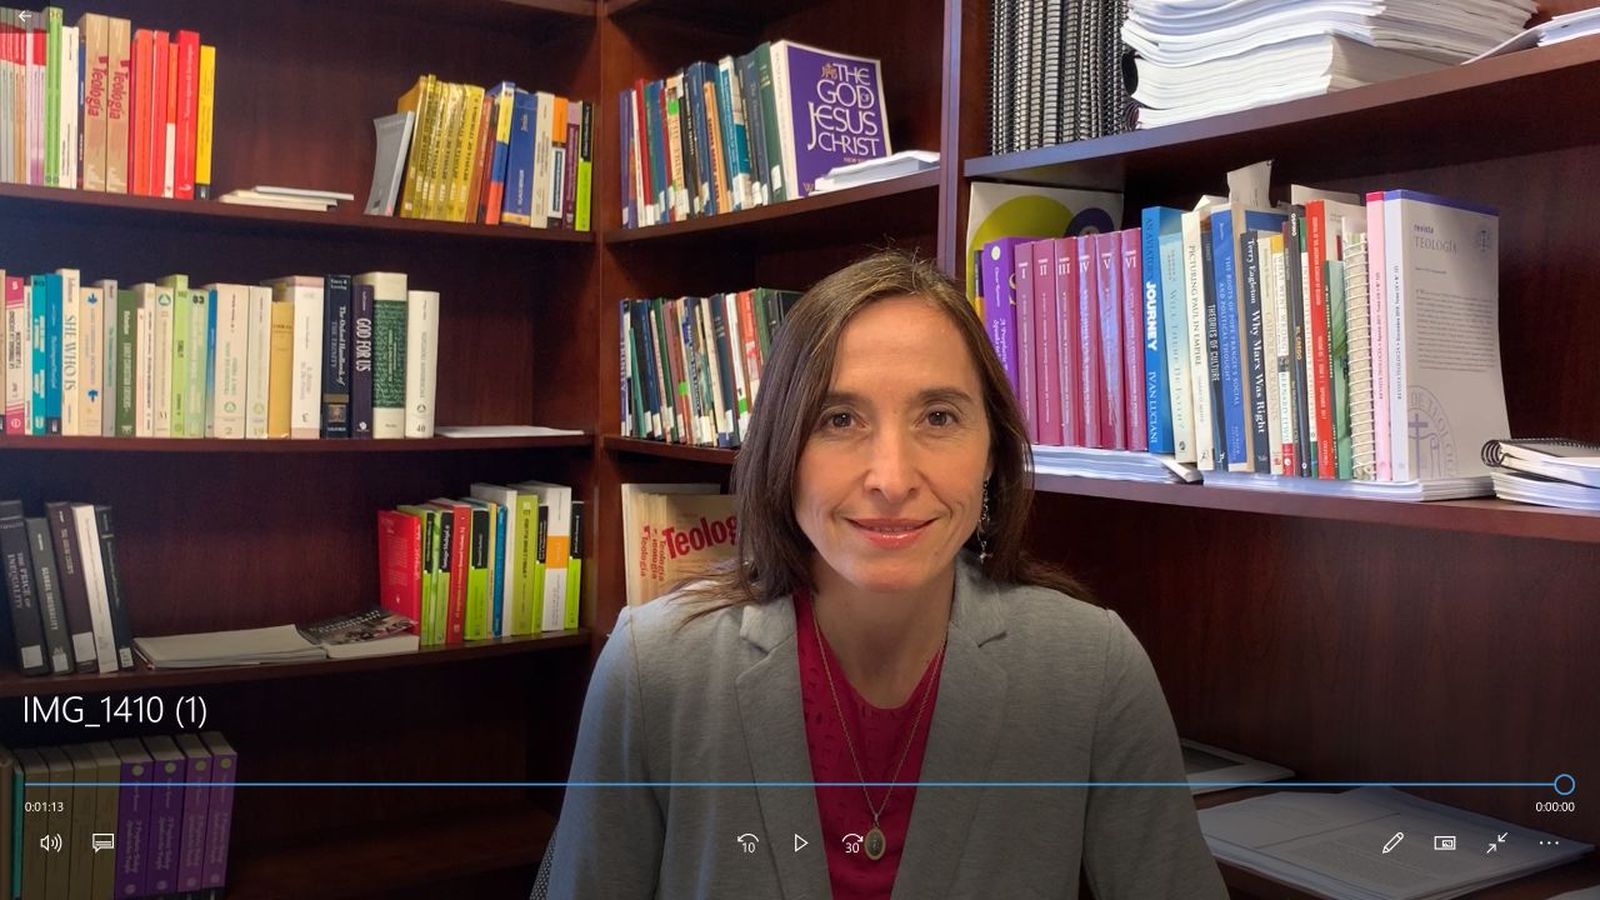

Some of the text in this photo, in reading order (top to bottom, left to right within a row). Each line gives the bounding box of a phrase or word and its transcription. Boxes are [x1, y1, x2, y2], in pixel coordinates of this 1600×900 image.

[833, 63, 870, 85] THE
[86, 67, 107, 116] Teología
[107, 70, 128, 119] Teología
[817, 79, 874, 109] GOD
[808, 101, 878, 150] JESUS
[818, 132, 879, 156] CHRIST
[1414, 224, 1434, 234] revista
[1415, 235, 1456, 254] TEOLOGÍA
[1040, 265, 1046, 276] II
[1059, 263, 1070, 275] III
[1080, 261, 1090, 273] IV
[1103, 258, 1111, 269] V
[1125, 256, 1136, 268] VI
[1189, 245, 1200, 299] PICTURING
[1246, 239, 1258, 304] Terry Eagleton
[1146, 281, 1158, 351] JOURNEY
[1190, 301, 1199, 319] PAUL
[1192, 321, 1200, 330] IN
[64, 315, 77, 390] SHE WHO IS
[356, 318, 372, 371] GOD FOR US
[1193, 333, 1202, 366] EMPIRE
[1207, 304, 1220, 382] THEORIES OF CULTURE
[1251, 310, 1266, 433] Why Marx Was Right
[1149, 372, 1159, 444] IVAN LUCIANI
[662, 515, 737, 559] Teolog
[7, 554, 23, 609] INEQUALITY
[19, 568, 31, 597] PRICE
